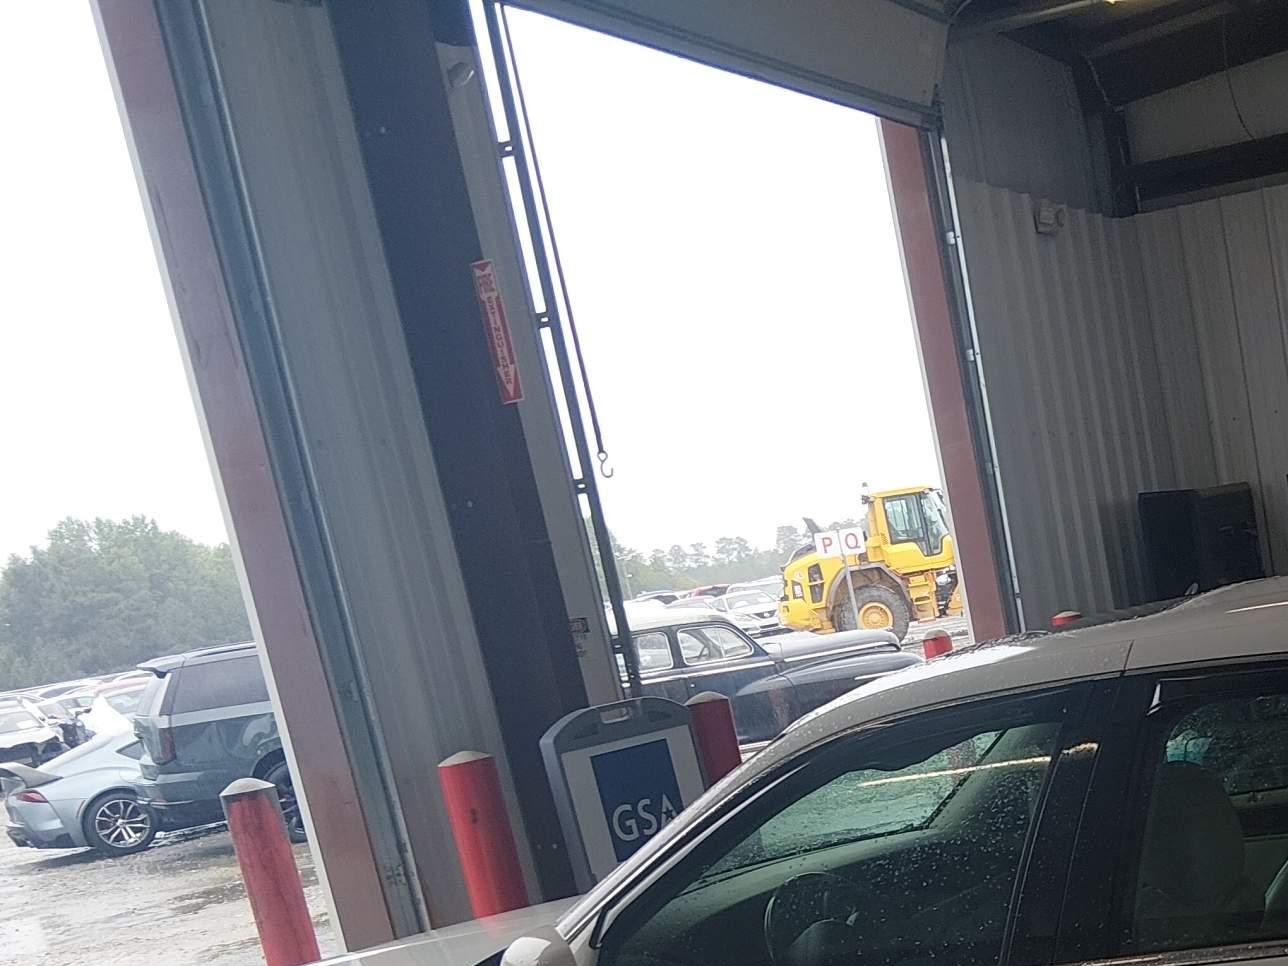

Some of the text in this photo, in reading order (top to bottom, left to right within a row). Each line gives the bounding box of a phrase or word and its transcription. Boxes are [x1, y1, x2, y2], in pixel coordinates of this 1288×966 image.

[487, 295, 513, 385] EXTINGUISHER
[822, 537, 833, 553] P
[845, 533, 861, 549] Q
[612, 793, 678, 842] GSA
